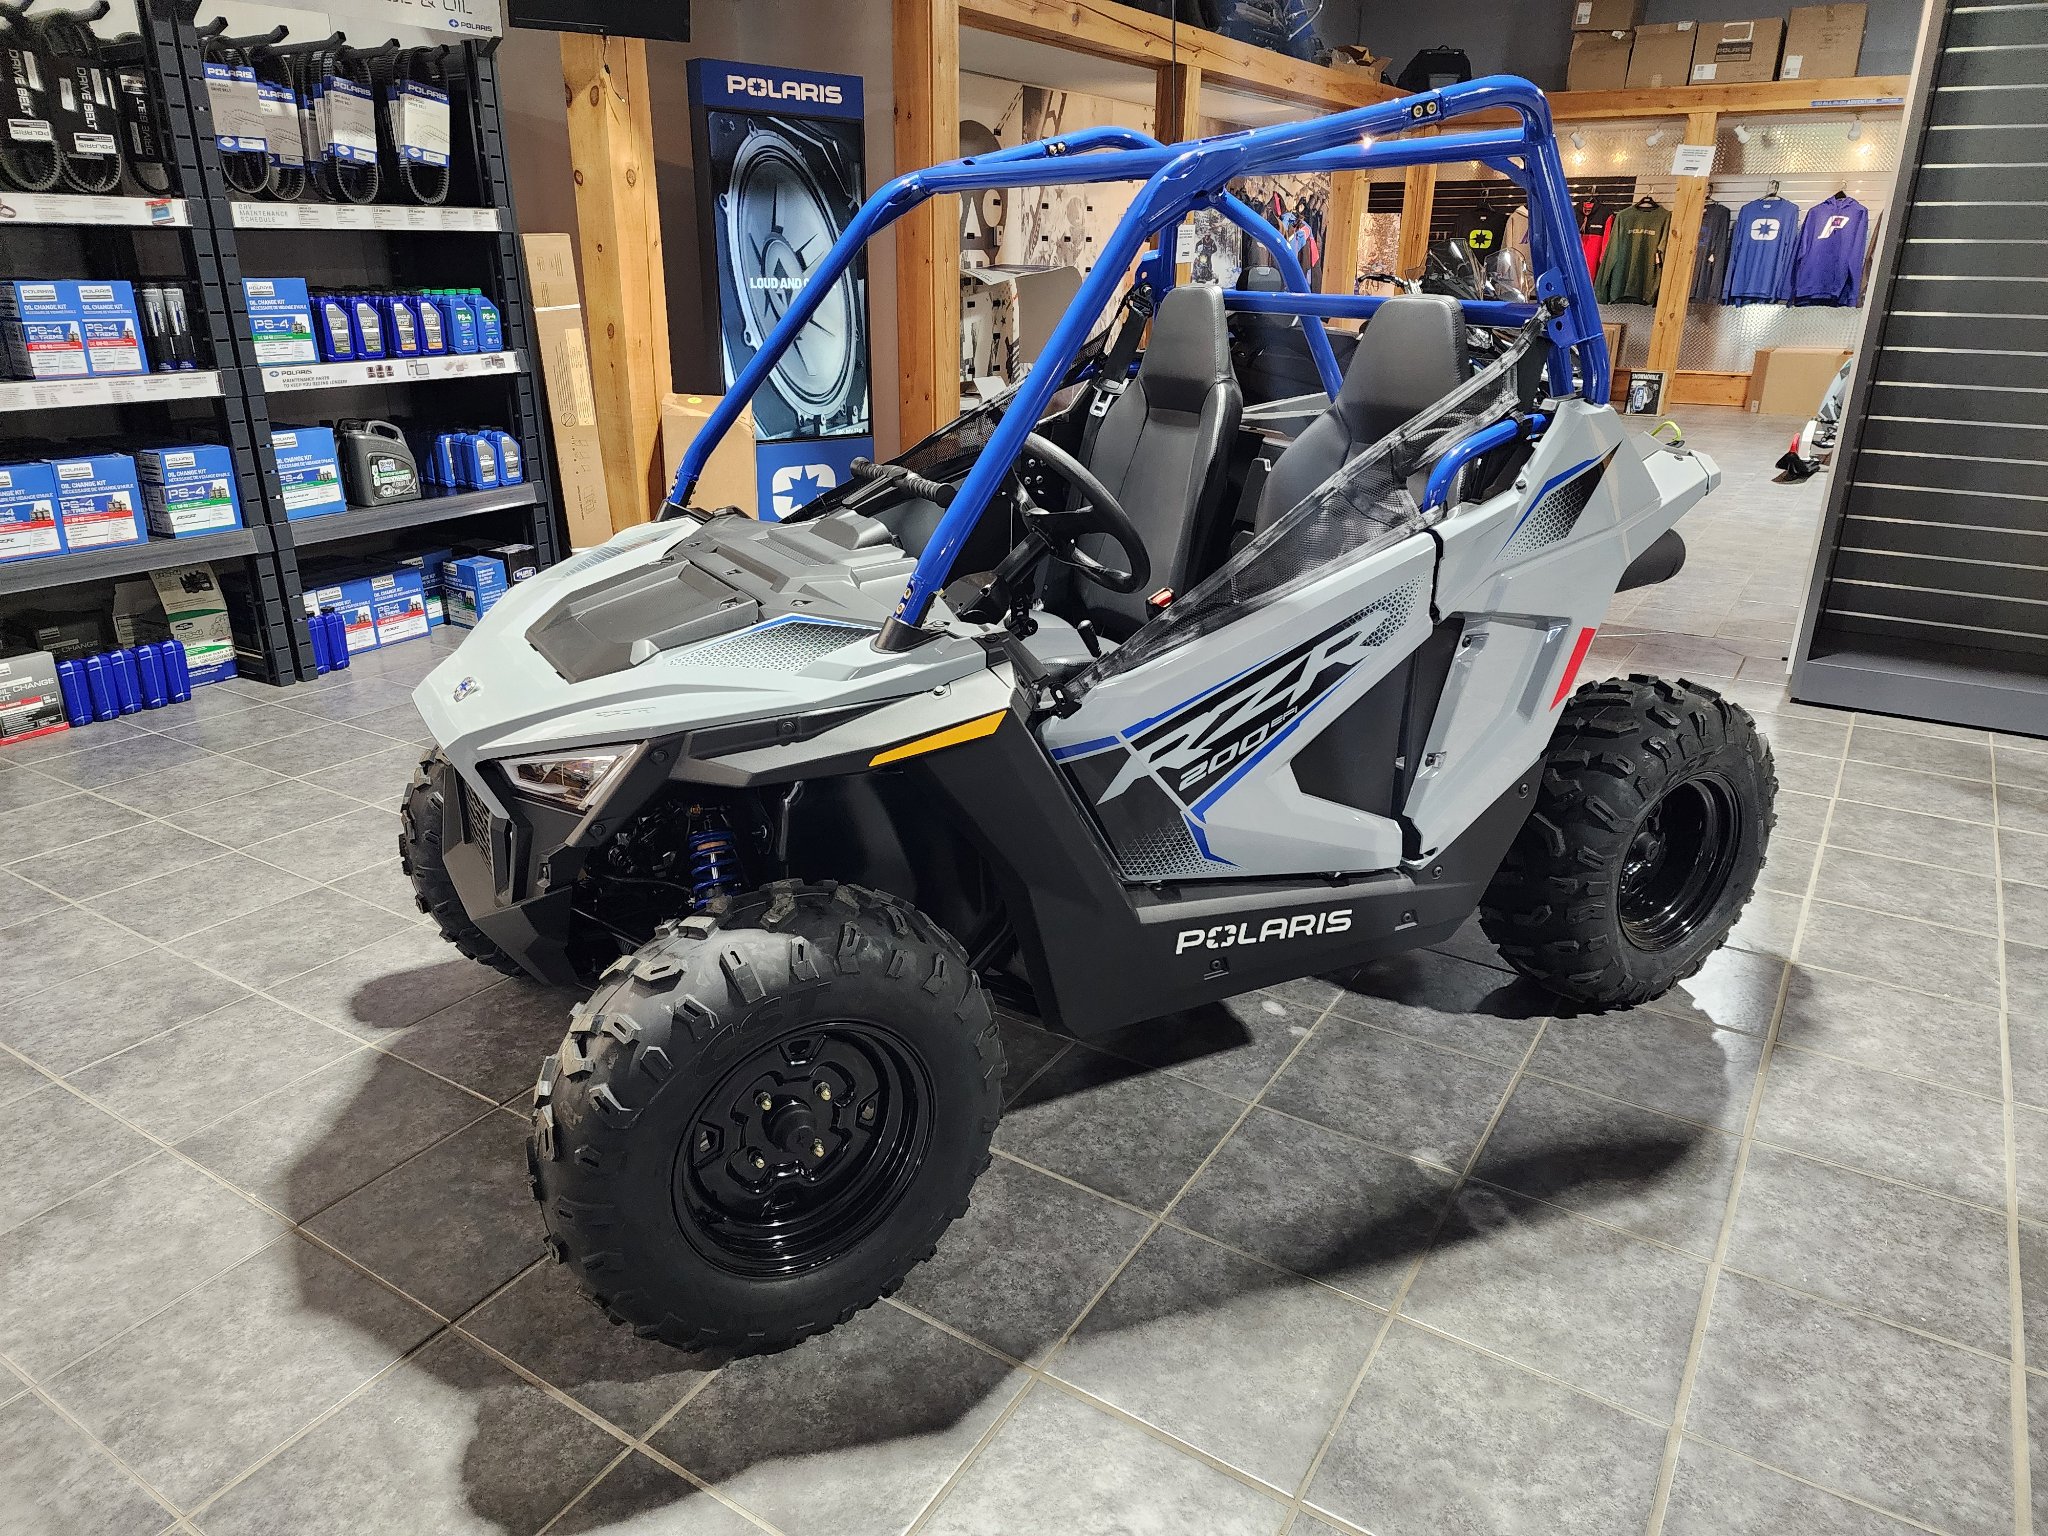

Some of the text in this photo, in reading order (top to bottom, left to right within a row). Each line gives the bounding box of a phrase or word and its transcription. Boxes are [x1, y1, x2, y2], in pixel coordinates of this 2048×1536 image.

[460, 22, 493, 32] POLARIS
[207, 67, 253, 79] POLARIS
[8, 49, 36, 118] DRIVE BELT
[333, 80, 372, 96] POLARIS
[726, 74, 843, 105] POLARIS
[76, 66, 98, 131] DRIVE BELT
[258, 89, 294, 100] OLARIS
[408, 84, 448, 101] POLARIS
[135, 97, 149, 123] BELT
[12, 129, 50, 137] POLARIS
[77, 142, 114, 150] POLARIS
[750, 277, 779, 289] LOUD
[780, 277, 802, 289] AND
[457, 313, 472, 321] PS-4
[28, 326, 62, 334] PS-4
[84, 323, 118, 332] PS-4
[254, 319, 290, 329] PS-4
[168, 485, 206, 500] PS-4
[60, 498, 95, 509] PS-4
[377, 603, 400, 614] PS-4
[61, 640, 99, 653] CHANGE
[12, 677, 55, 693] CHANGE
[1096, 608, 1398, 806] RZR
[1178, 705, 1299, 792] 200 EFI
[1175, 909, 1353, 954] POLARIS
